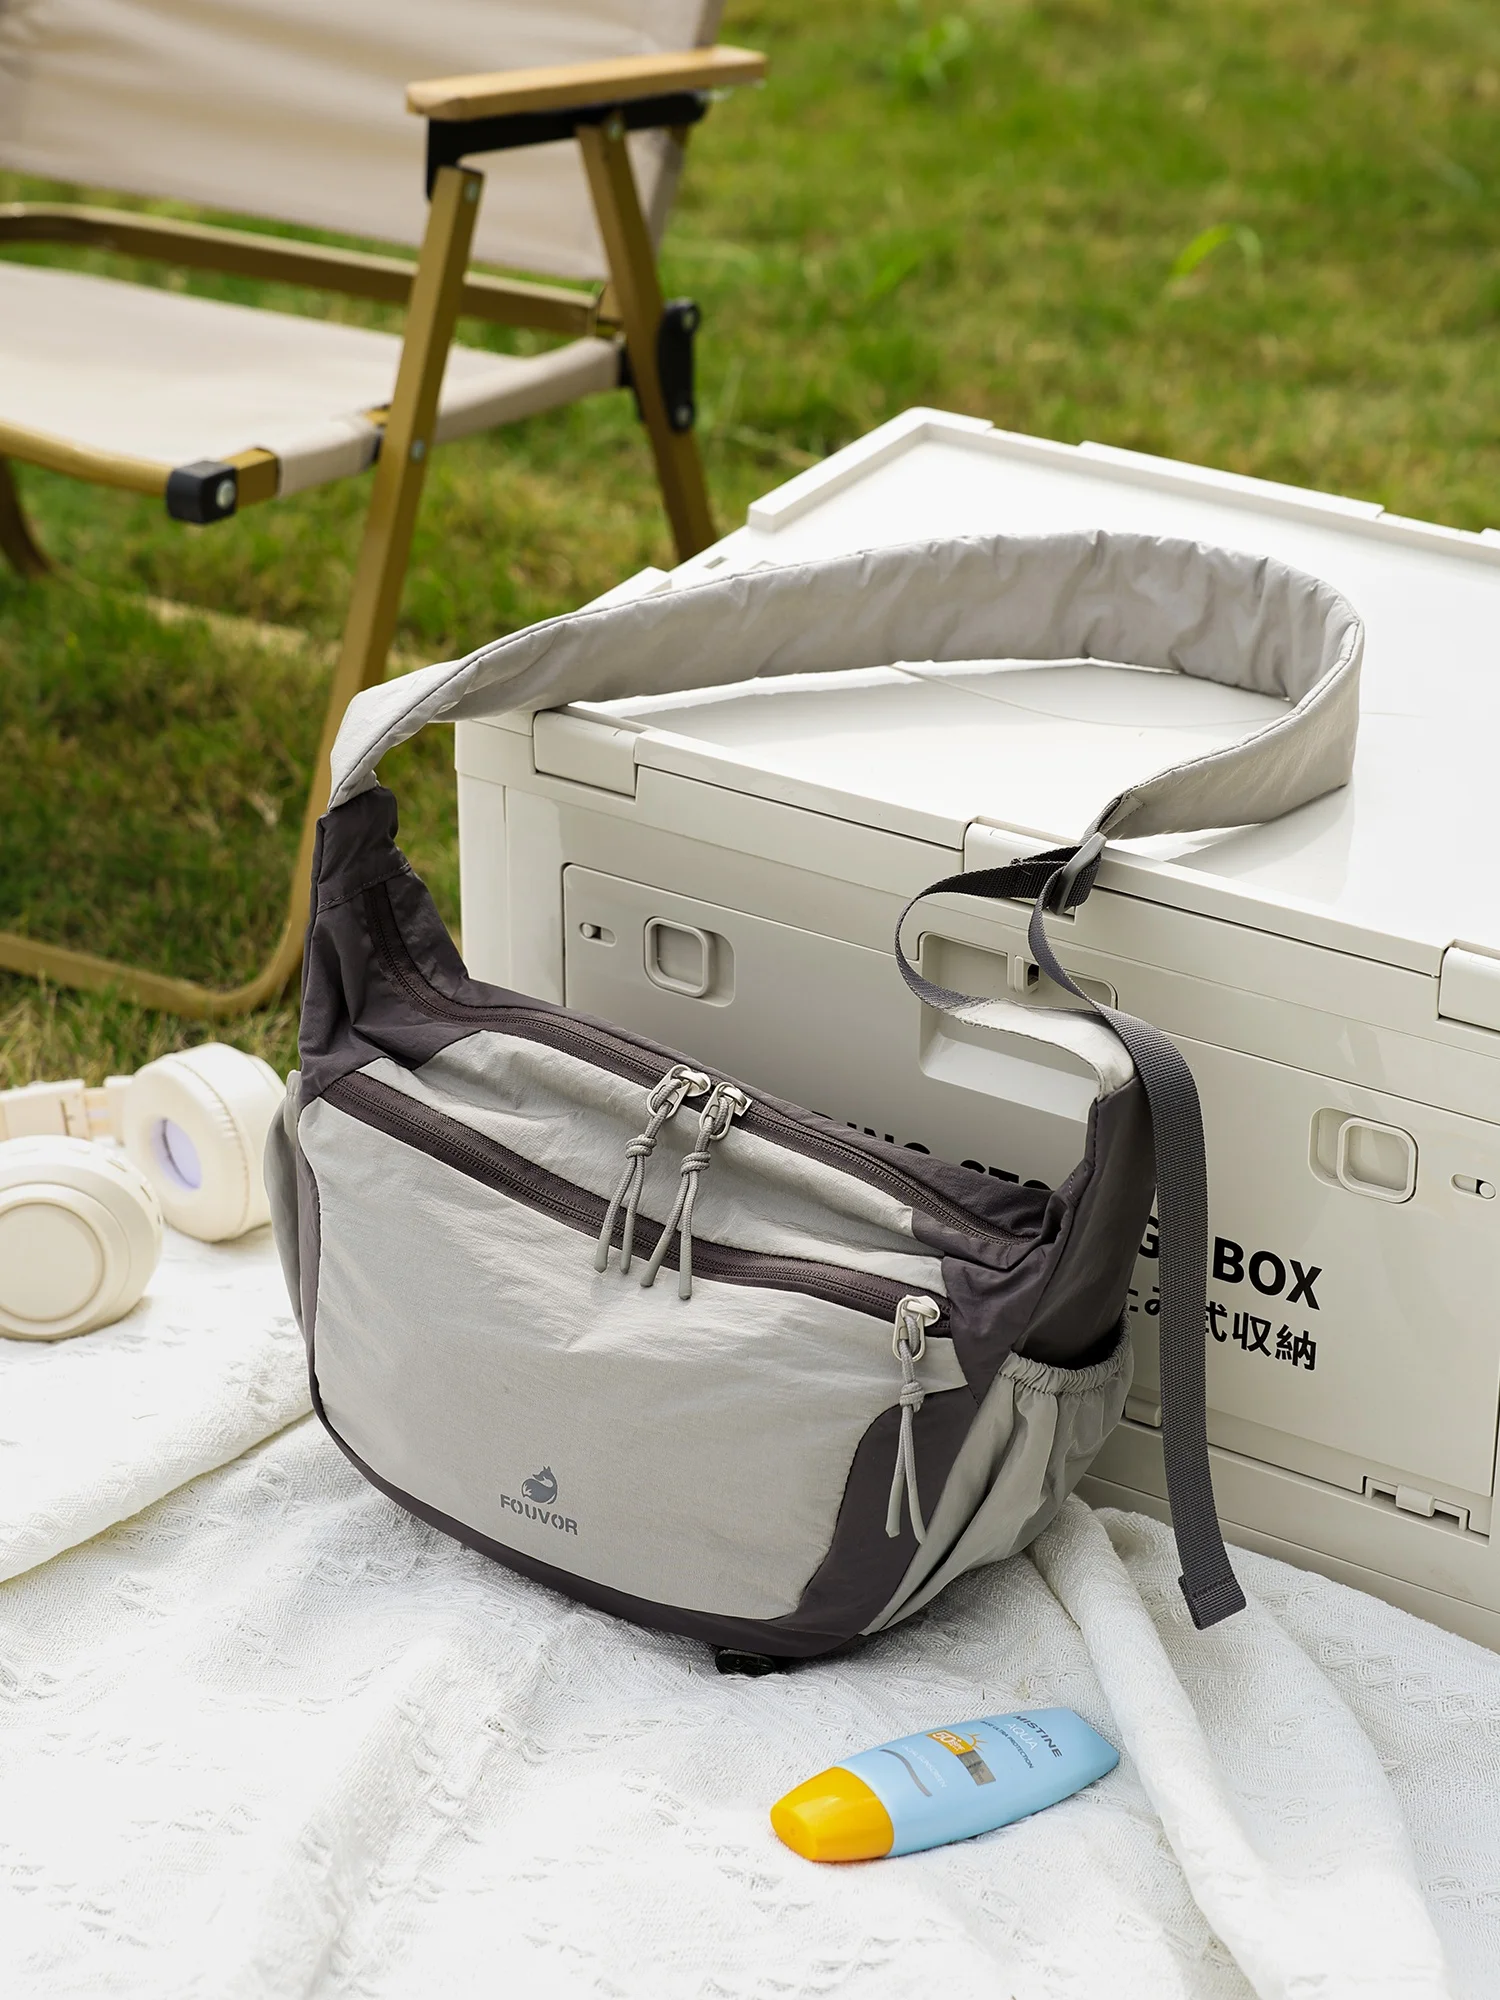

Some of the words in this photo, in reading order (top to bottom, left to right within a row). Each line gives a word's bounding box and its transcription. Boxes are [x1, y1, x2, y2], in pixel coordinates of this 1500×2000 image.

[1212, 1236, 1323, 1311] BOX
[500, 1494, 578, 1535] FOUVOR
[1004, 1723, 1038, 1750] AQUA
[1007, 1736, 1034, 1769] PROTECTION
[1012, 1715, 1063, 1758] MISTINE
